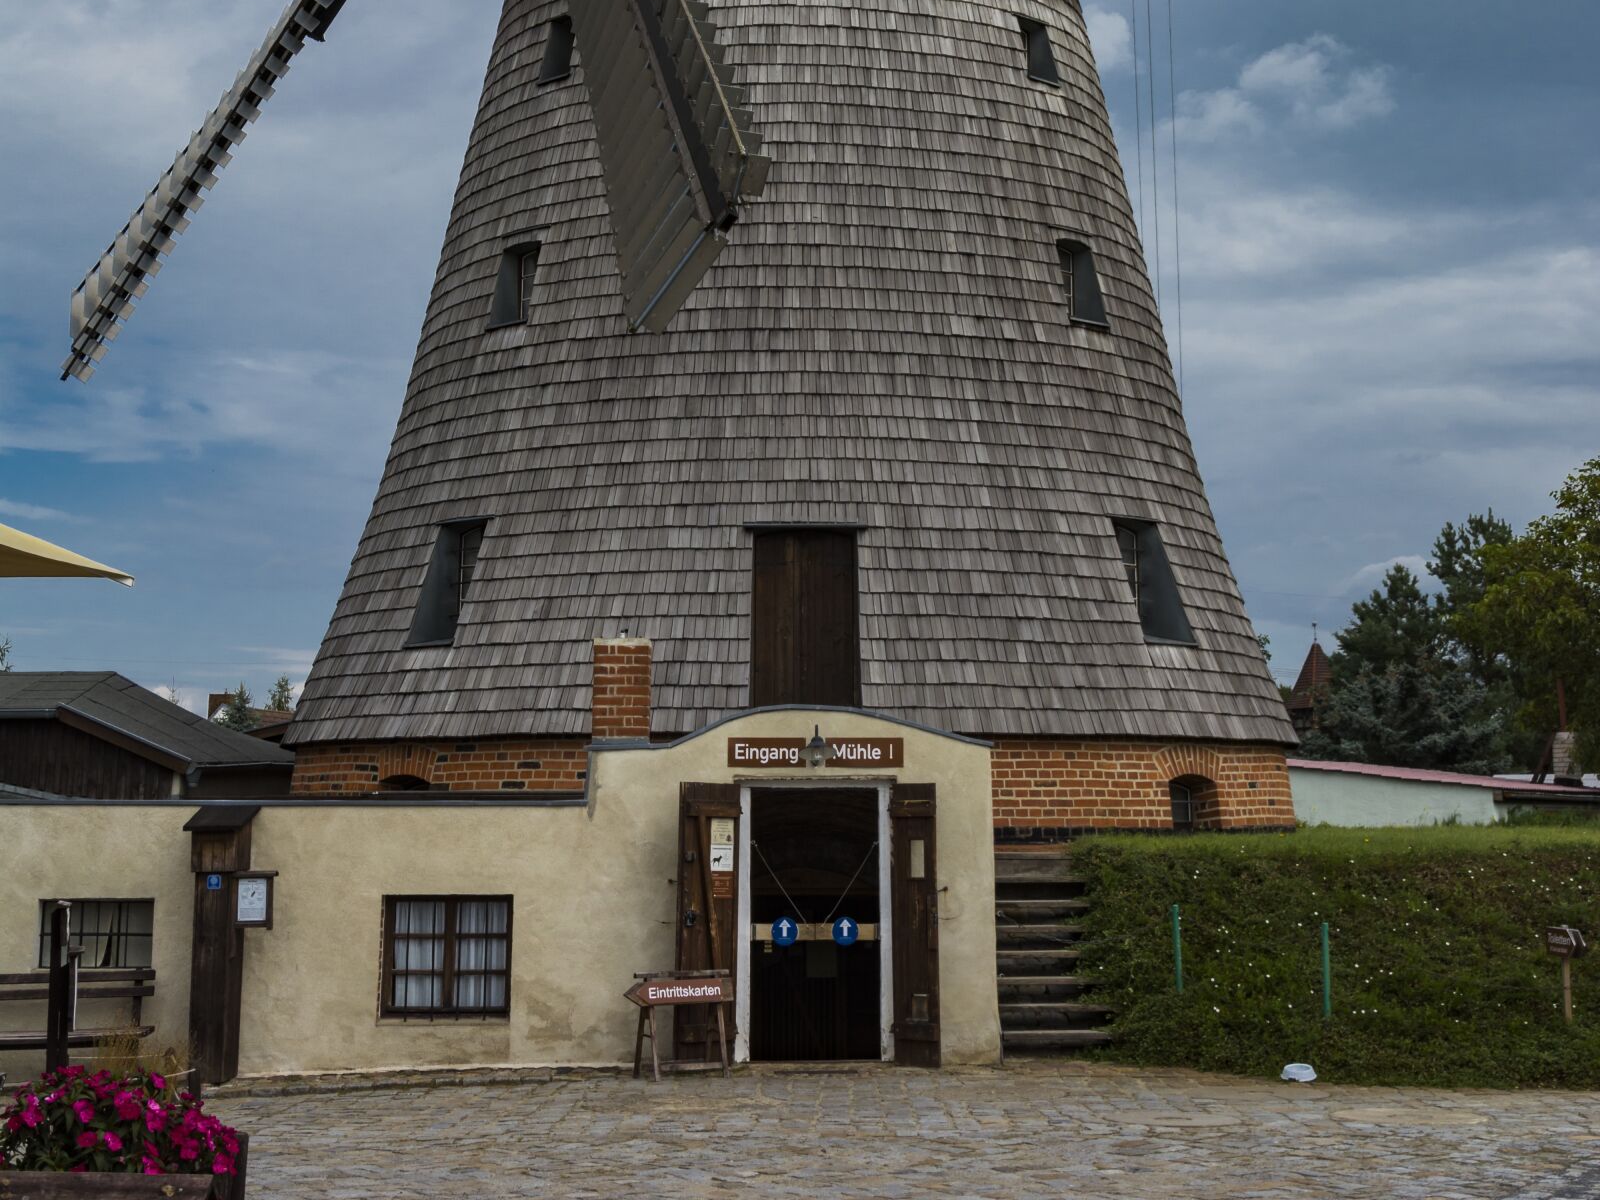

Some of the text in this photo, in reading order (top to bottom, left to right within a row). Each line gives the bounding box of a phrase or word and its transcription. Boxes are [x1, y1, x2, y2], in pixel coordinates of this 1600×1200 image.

[735, 743, 799, 763] Eingang
[833, 743, 881, 759] Mühle
[648, 985, 721, 999] Eintrittskarten
